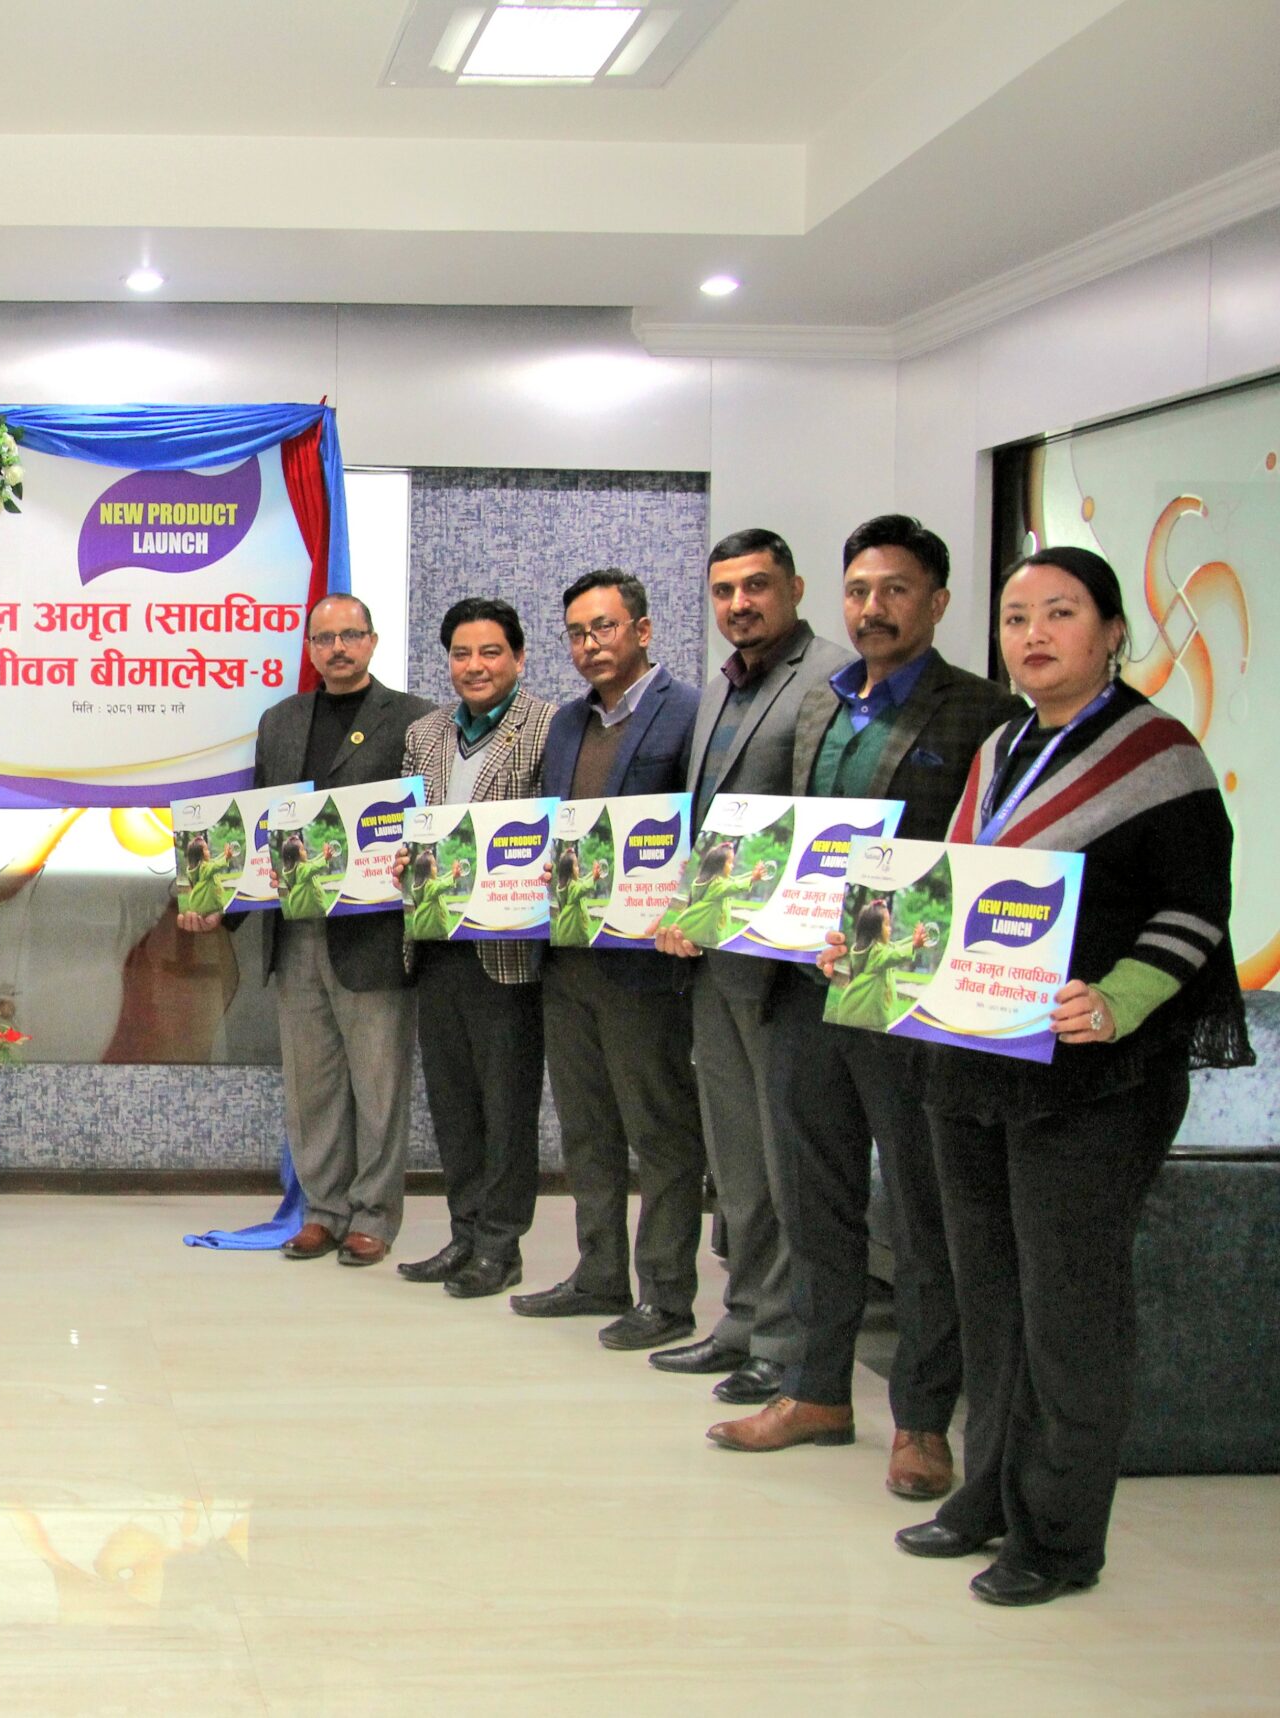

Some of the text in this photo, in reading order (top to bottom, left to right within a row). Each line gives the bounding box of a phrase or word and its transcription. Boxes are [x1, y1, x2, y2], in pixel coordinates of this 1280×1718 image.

[99, 503, 238, 525] NEW PRODUCT
[133, 532, 209, 554] LAUNCH
[33, 602, 131, 641] अमृत
[144, 593, 306, 633] (सावधिक
[90, 647, 283, 689] बीमालेख-४
[72, 700, 94, 714] मिति
[493, 835, 542, 847] NEW PRODUCT
[811, 840, 832, 853] NEW
[504, 848, 532, 860] LAUNCH
[977, 898, 1051, 921] NEW PRODUCT
[992, 918, 1033, 938] LAUNCH
[950, 959, 973, 972] बाल
[975, 962, 1004, 979] अमृत
[954, 976, 985, 994] जीवन
